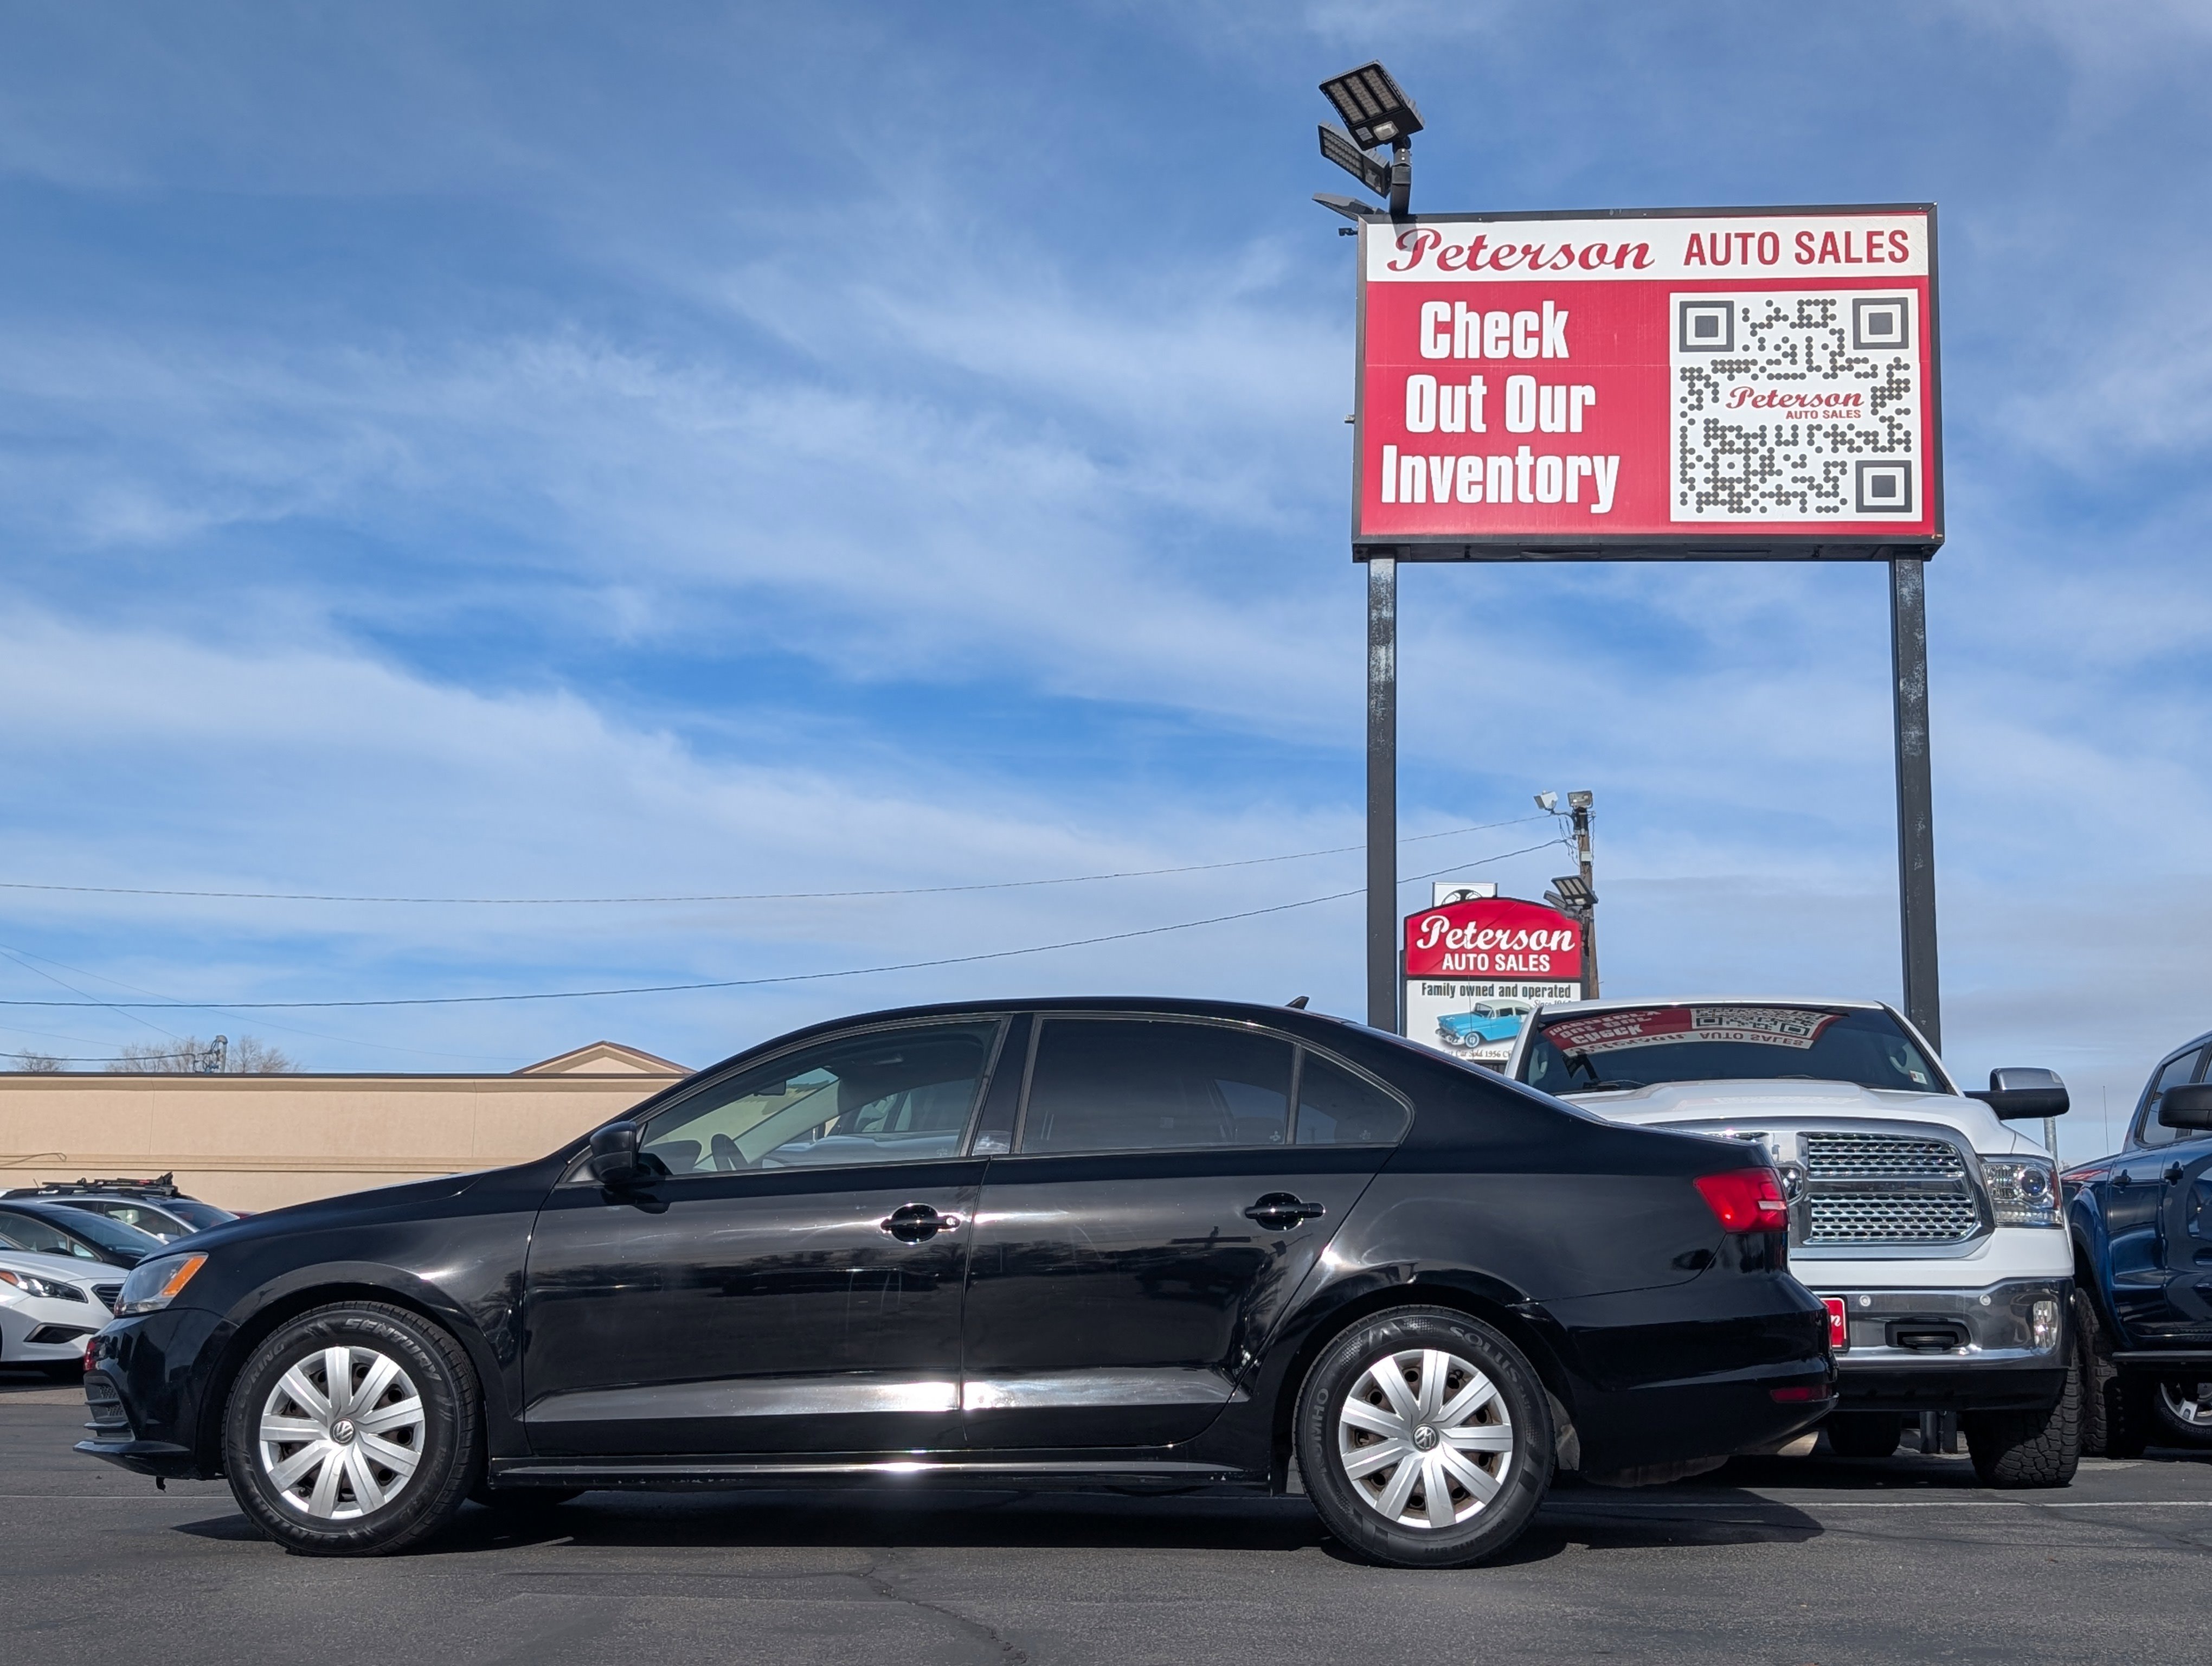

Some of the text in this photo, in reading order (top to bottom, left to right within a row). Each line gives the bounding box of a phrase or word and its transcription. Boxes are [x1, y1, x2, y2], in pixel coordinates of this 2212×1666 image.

[1387, 228, 1909, 272] Peterson AUTO SALES
[1420, 300, 1570, 359] Check
[1405, 374, 1596, 433] Out Our
[1726, 386, 1864, 408] Peterson
[1785, 409, 1861, 419] AUTO SALES
[1381, 444, 1620, 514] Inventory
[1417, 915, 1575, 952] Peterson
[1442, 953, 1551, 972] AUTO SALES
[1422, 982, 1571, 1000] Family owned and operated
[1468, 1049, 1484, 1058] Sold
[1485, 1050, 1501, 1058] 1956
[341, 1317, 442, 1382] SENTURY
